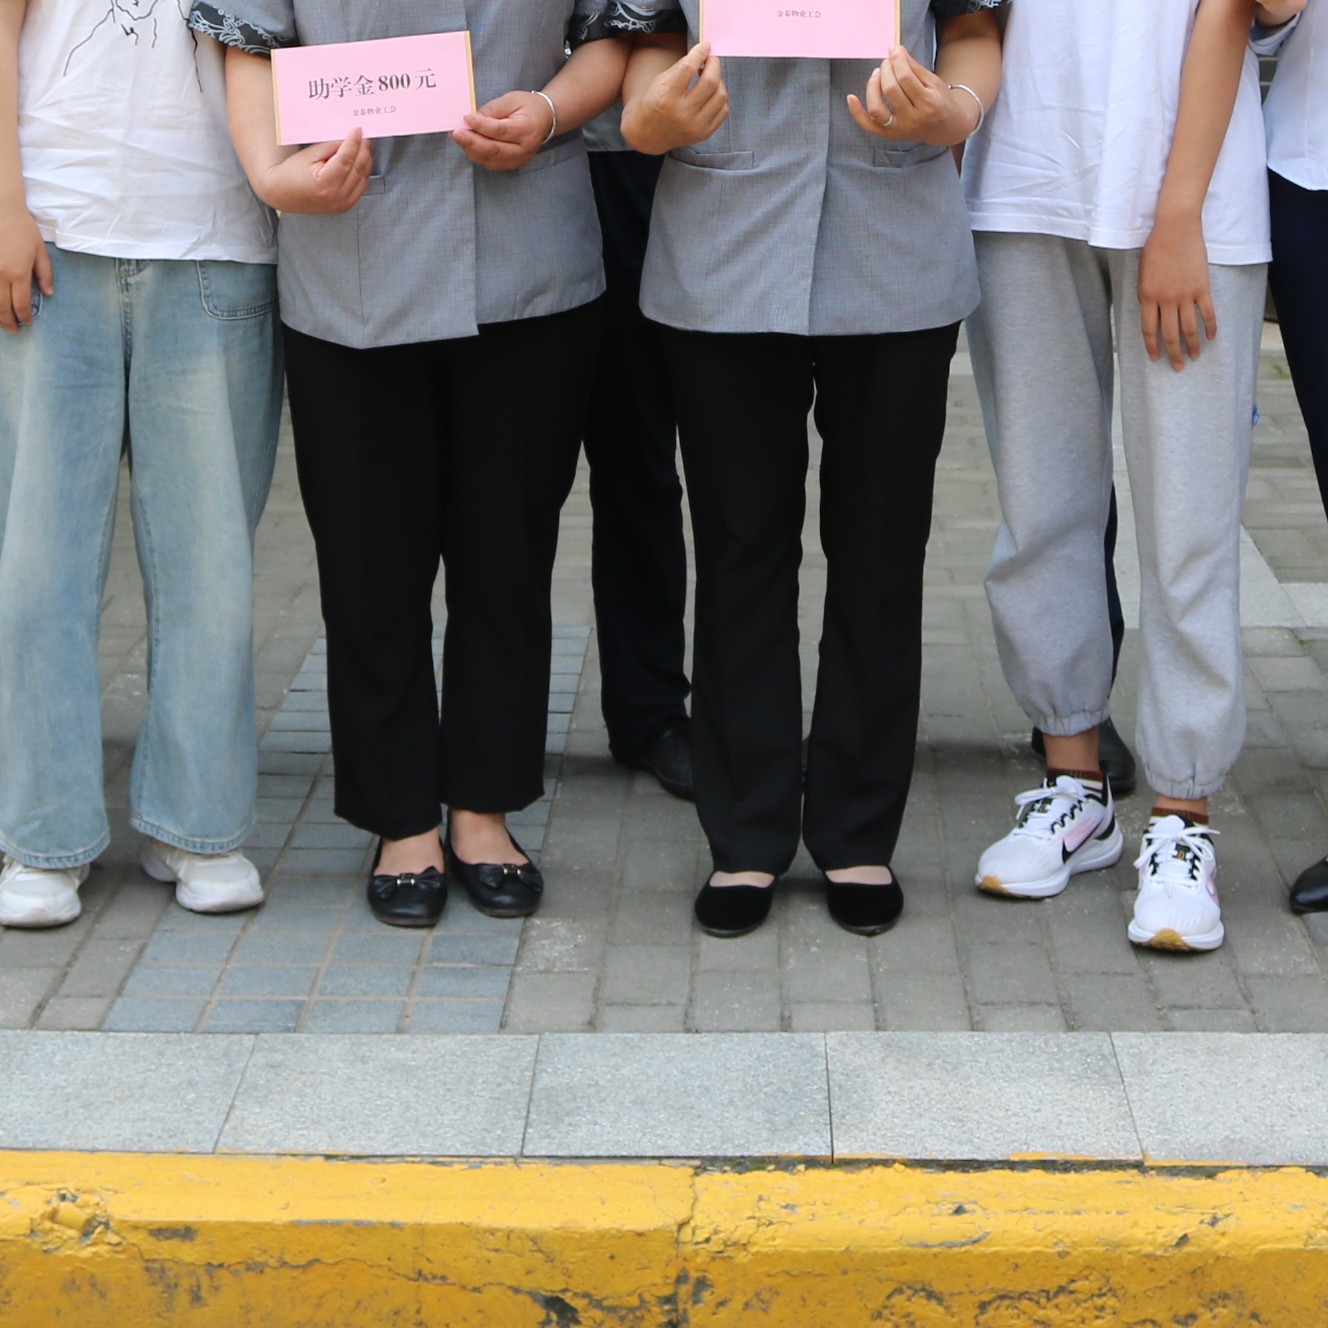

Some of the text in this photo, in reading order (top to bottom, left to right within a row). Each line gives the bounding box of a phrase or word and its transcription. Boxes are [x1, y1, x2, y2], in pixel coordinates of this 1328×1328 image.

[777, 9, 822, 19] 金泰物业工会
[352, 105, 397, 118] 金泰物业工会
